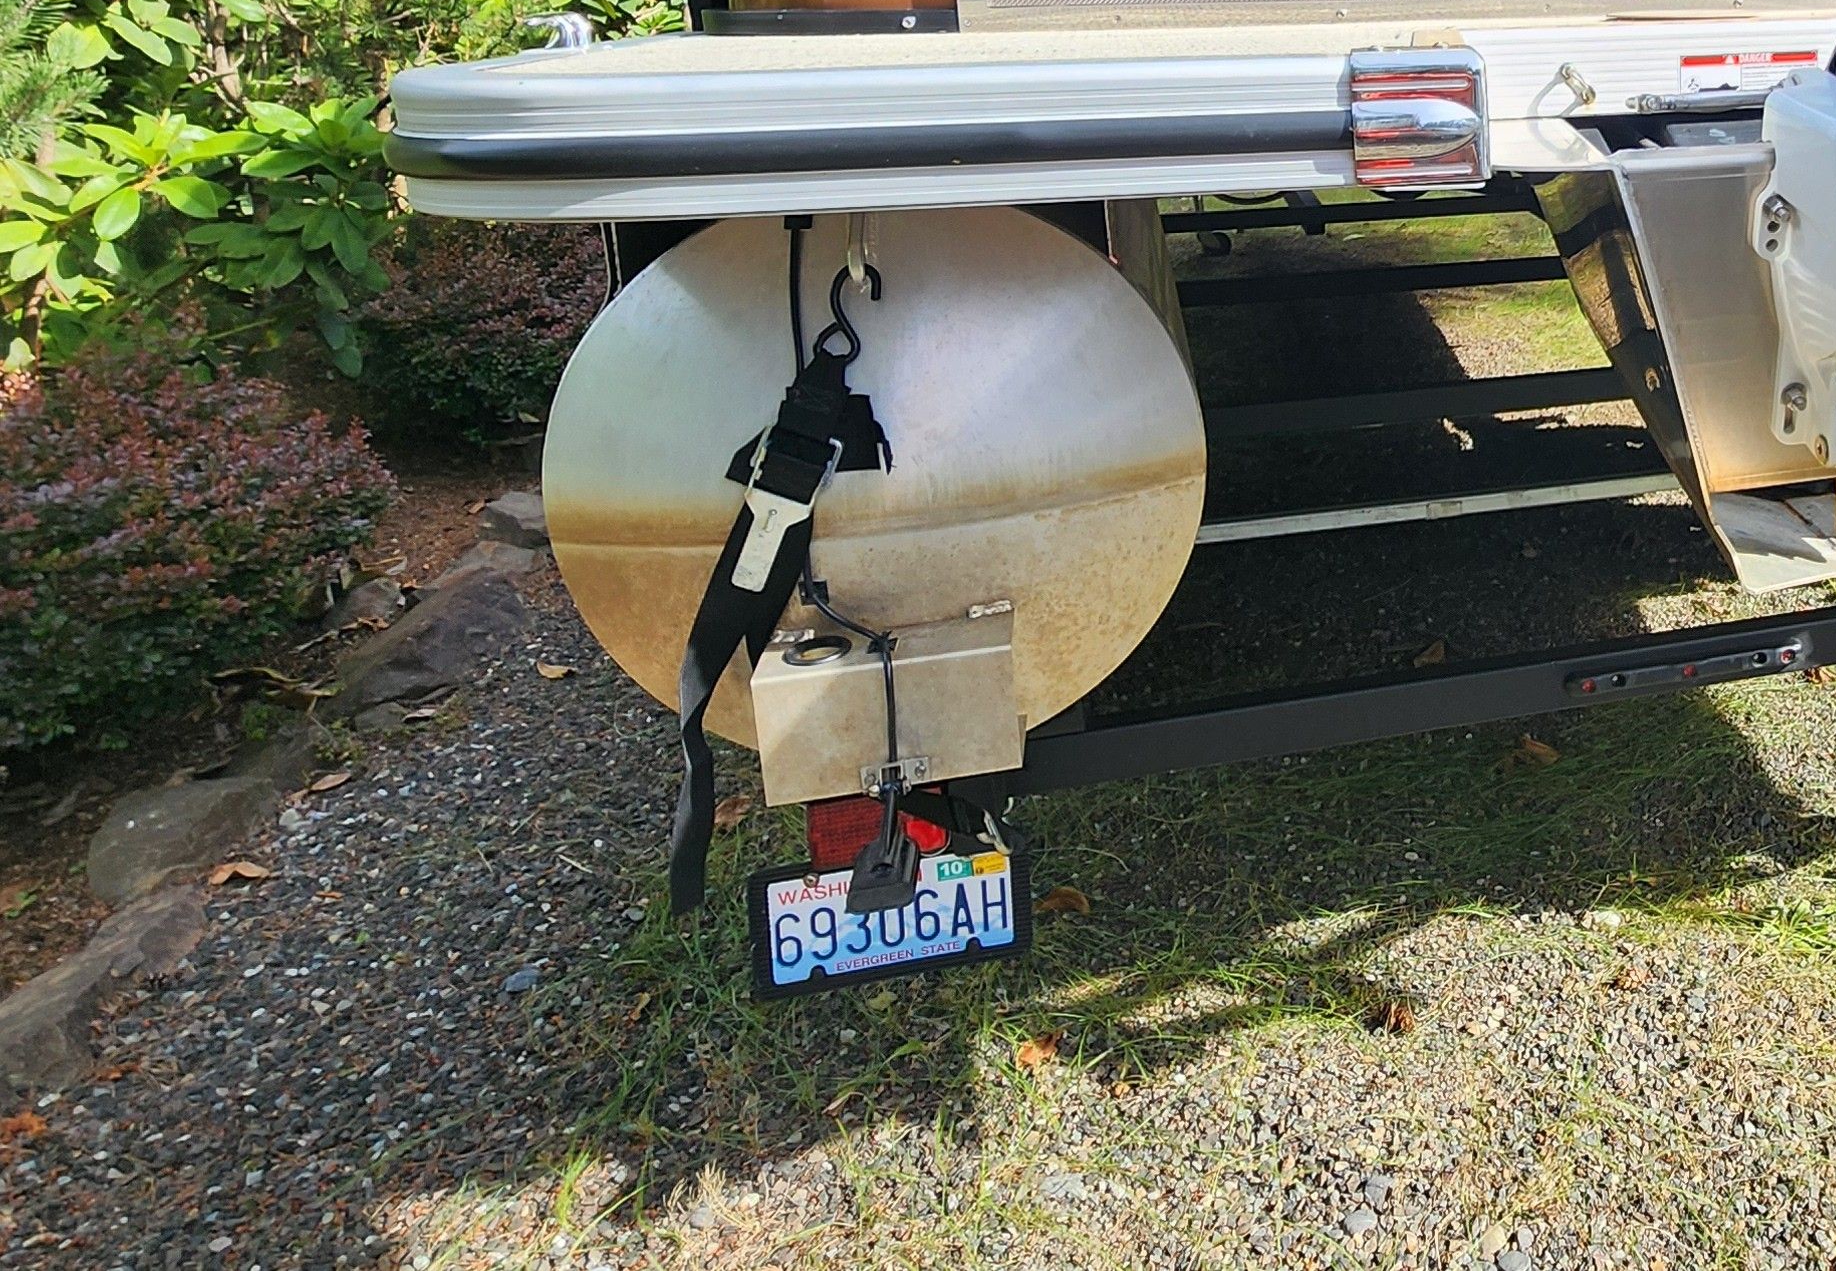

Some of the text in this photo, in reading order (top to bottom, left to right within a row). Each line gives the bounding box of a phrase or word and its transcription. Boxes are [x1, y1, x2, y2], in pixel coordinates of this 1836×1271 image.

[1738, 52, 1773, 64] DANGER
[939, 861, 964, 877] 10
[774, 877, 1008, 967] 69306AH
[836, 940, 961, 972] EVERGREEN STATE
